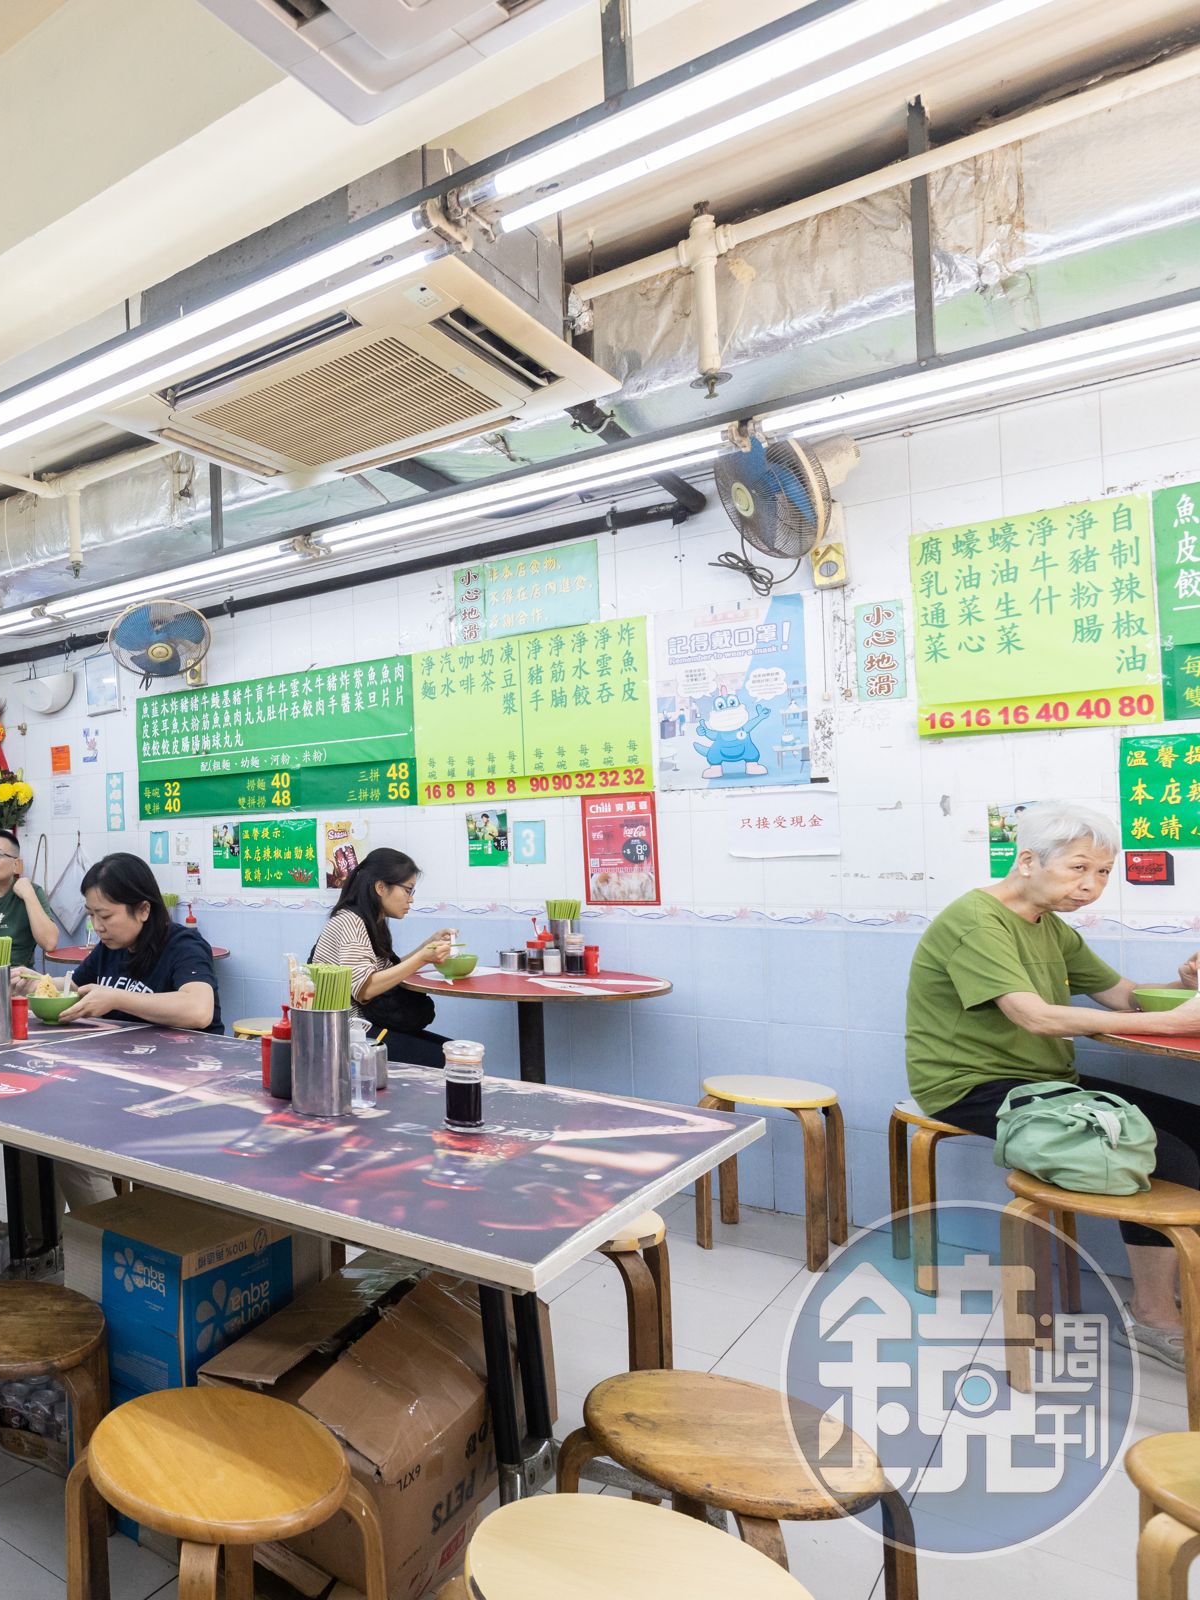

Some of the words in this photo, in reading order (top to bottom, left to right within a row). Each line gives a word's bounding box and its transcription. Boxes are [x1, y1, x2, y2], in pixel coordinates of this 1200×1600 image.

[1026, 516, 1061, 616] 淨牛什
[1066, 508, 1104, 644] 淨豬粉腸
[460, 569, 481, 640] 小心地滑
[916, 536, 951, 664] 腐乳通菜
[952, 529, 985, 653] 蠔油菜心
[988, 522, 1024, 655] 蠔油生菜
[1108, 503, 1148, 674] 自制辣椒油
[479, 648, 496, 693] 奶茶
[549, 635, 567, 709] 淨筋腩
[571, 632, 591, 706] 淨水餃
[594, 628, 614, 704] 淨雲吞
[617, 622, 639, 703] 炸魚皮
[669, 654, 712, 665] Remember
[713, 652, 723, 660] to
[724, 650, 746, 659] wear
[753, 645, 778, 656] mask
[863, 605, 899, 697] 小心地滑
[421, 656, 436, 700] 淨麵
[440, 653, 456, 698] 汽水
[458, 652, 476, 695] 咖啡
[500, 642, 518, 715] 凍豆漿
[526, 638, 544, 712] 淨豬手
[925, 712, 955, 730] 16
[961, 709, 991, 728] 16
[998, 705, 1029, 726] 16
[1036, 702, 1069, 723] 40
[1076, 698, 1111, 719] 40
[1118, 694, 1154, 716] 80
[164, 782, 180, 797] 32
[271, 772, 290, 789] 40
[386, 762, 409, 780] 48
[388, 782, 410, 800] 56
[425, 785, 441, 799] 16
[446, 784, 455, 798] 8
[466, 782, 475, 796] 8
[487, 781, 496, 795] 8
[507, 779, 516, 794] 8
[529, 776, 549, 792] 90
[551, 774, 572, 791] 90
[575, 772, 596, 789] 32
[598, 770, 620, 787] 32
[623, 768, 645, 786] 32
[164, 798, 180, 812] 40
[271, 790, 291, 806] 48
[590, 802, 611, 813] Chill
[521, 829, 536, 857] 3
[740, 814, 823, 829] 只接受現金
[155, 838, 163, 858] 4
[137, 1265, 166, 1284] aqua
[143, 1278, 166, 1297] bon
[230, 1280, 270, 1311] aqua
[432, 1467, 477, 1535] PETS
